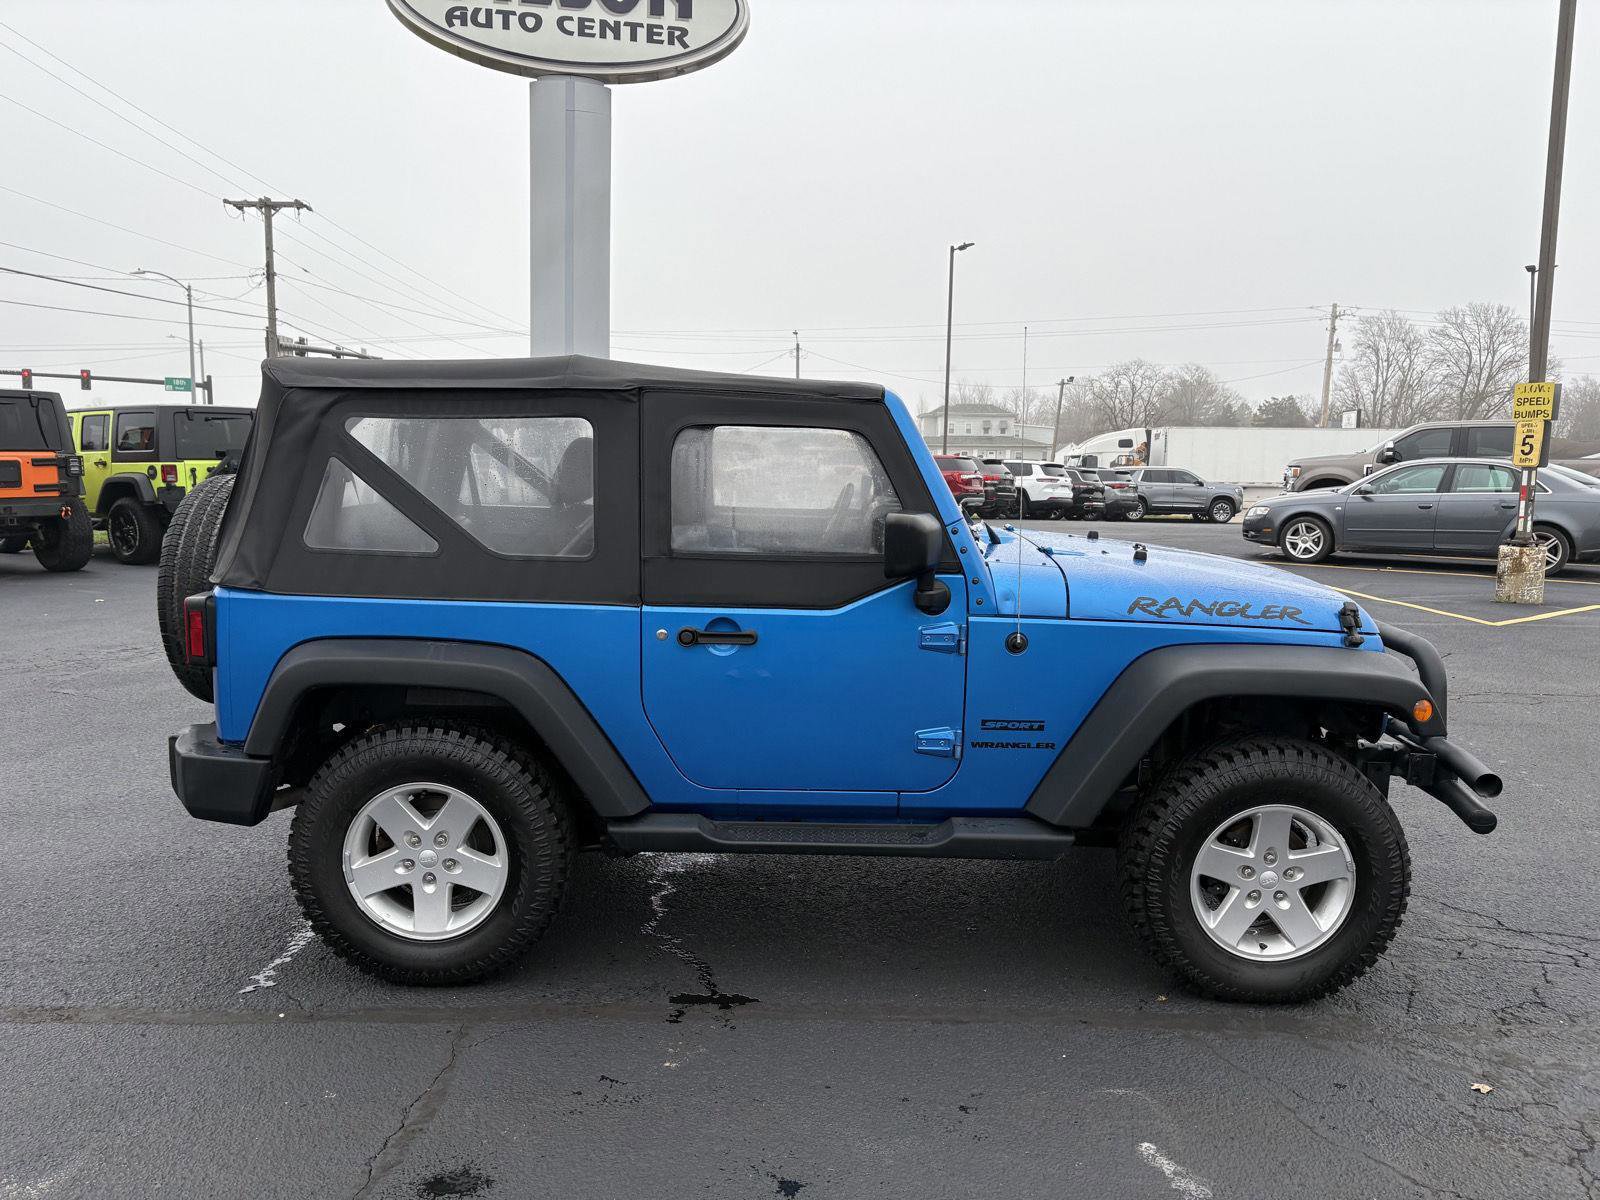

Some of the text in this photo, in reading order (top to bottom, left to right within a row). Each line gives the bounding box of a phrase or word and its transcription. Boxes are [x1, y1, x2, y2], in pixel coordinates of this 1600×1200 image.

[445, 6, 543, 33] AUTO
[556, 15, 690, 50] CENTER
[1516, 397, 1550, 406] SPEED
[1514, 409, 1549, 418] BUMPS
[1520, 434, 1534, 456] 5
[1127, 596, 1314, 626] RANGLER
[982, 720, 1043, 730] SPORT
[971, 741, 1056, 750] WRANGLER
